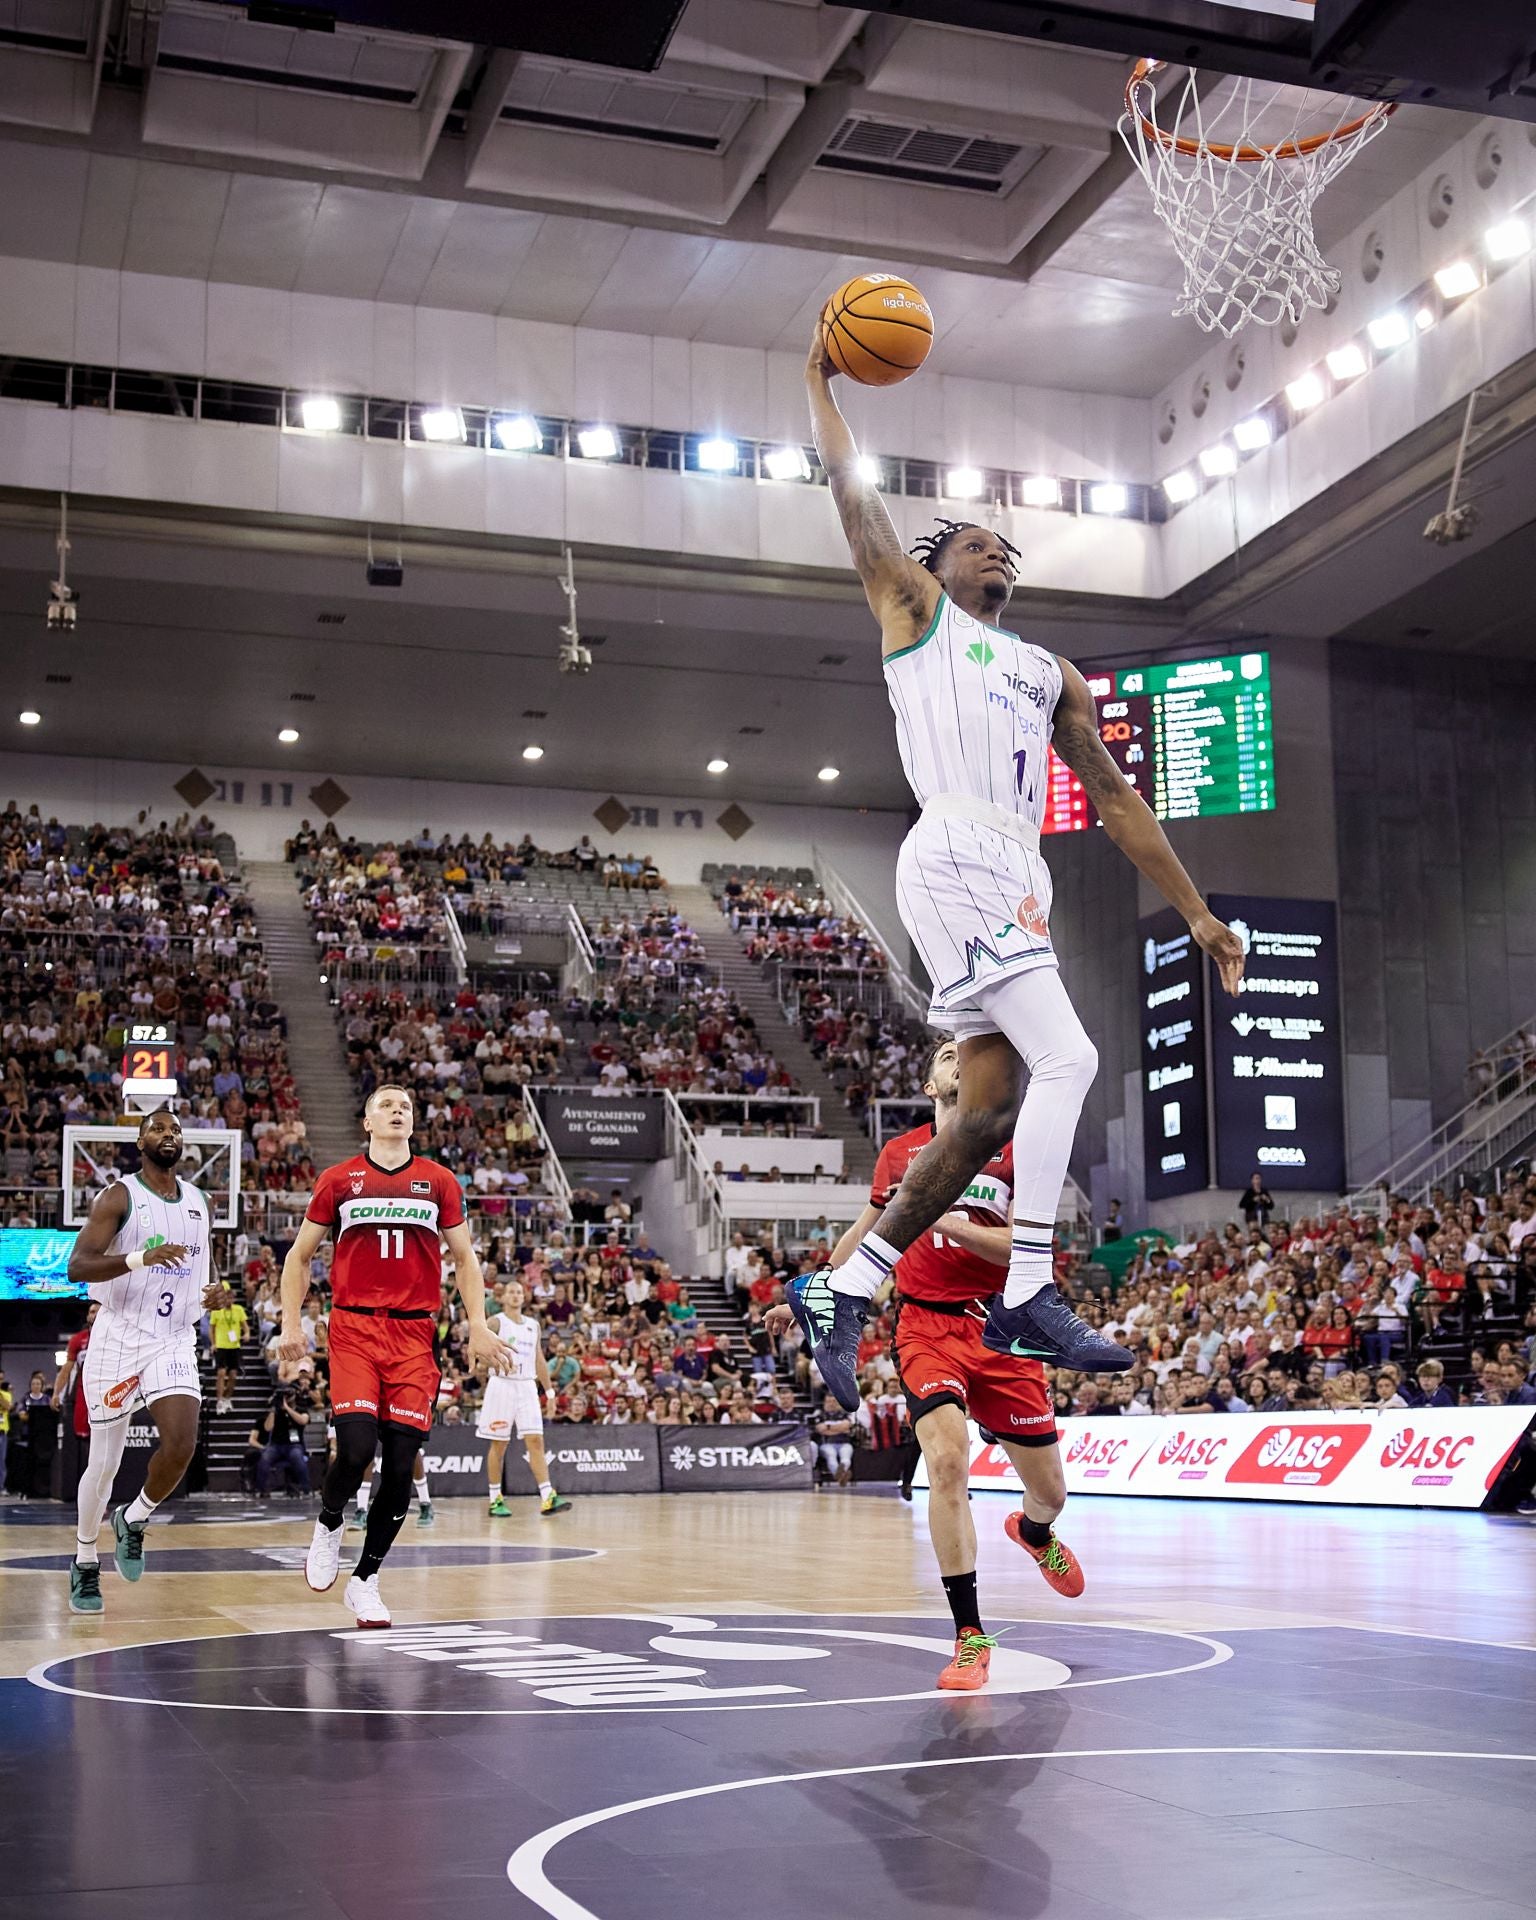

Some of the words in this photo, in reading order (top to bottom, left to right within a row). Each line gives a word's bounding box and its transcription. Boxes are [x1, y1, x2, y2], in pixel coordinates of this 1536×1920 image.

[1122, 673, 1143, 692] 41
[1102, 723, 1131, 742] 2Q
[1246, 977, 1319, 997] emasagra
[132, 1050, 169, 1079] 21
[562, 1107, 647, 1121] AYUNTAMIENTO
[568, 1123, 583, 1133] DE
[586, 1121, 639, 1134] GRANADA
[377, 1229, 404, 1259] 11
[157, 1292, 174, 1317] 3
[557, 1449, 592, 1463] CAJA
[595, 1449, 645, 1462] RURAL
[698, 1446, 805, 1467] STRADA
[576, 1463, 627, 1472] GRANADA
